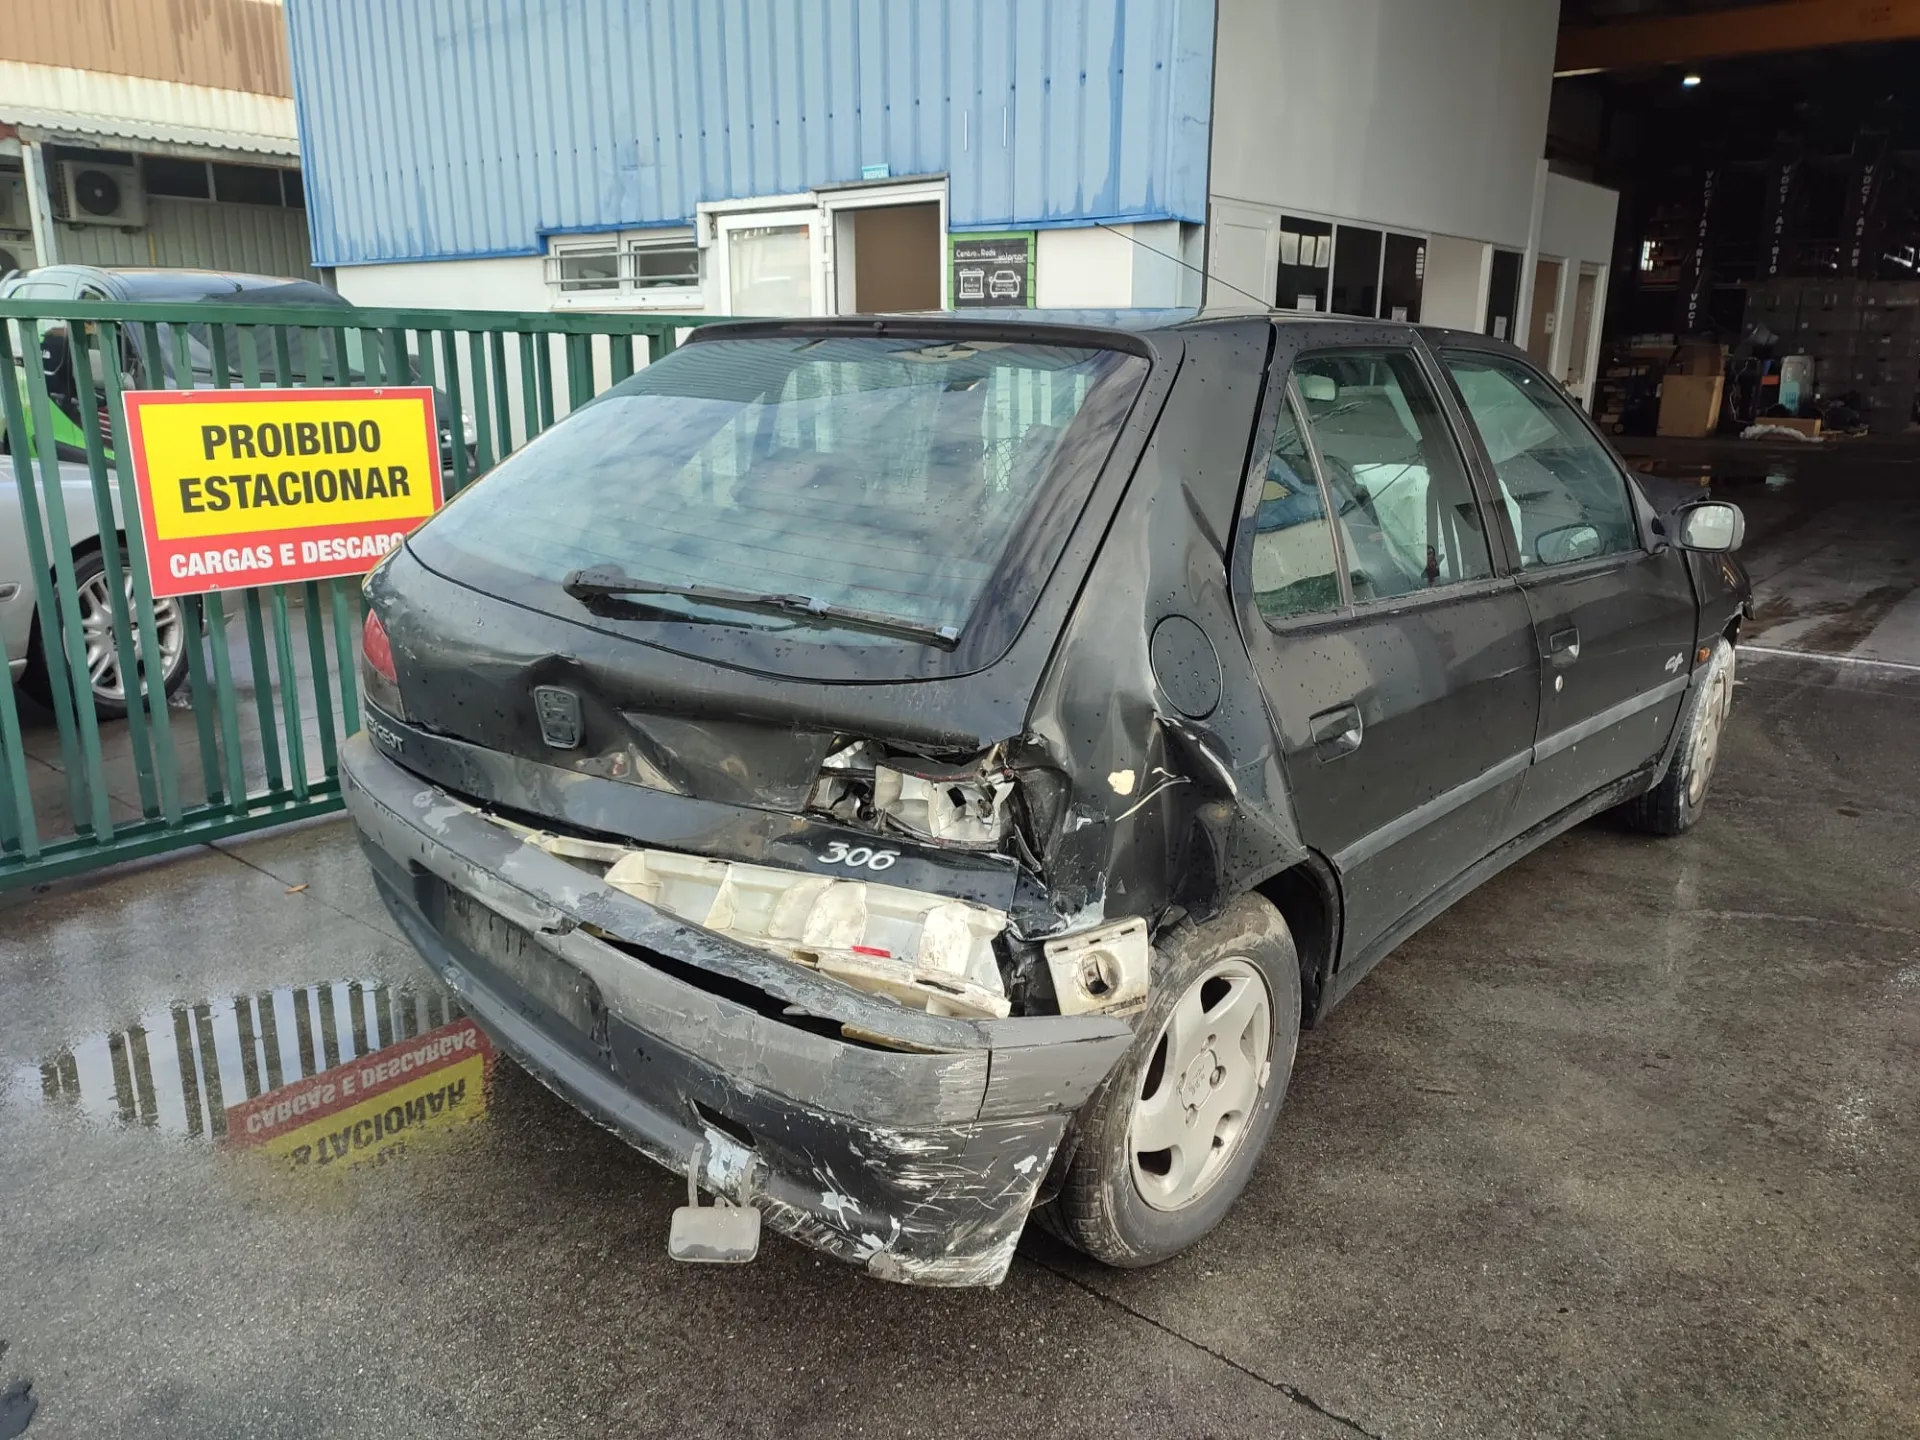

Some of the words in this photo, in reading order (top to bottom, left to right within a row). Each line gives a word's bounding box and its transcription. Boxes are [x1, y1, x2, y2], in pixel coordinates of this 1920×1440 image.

[956, 249, 977, 258] Centro
[201, 419, 380, 460] PROIBIDO
[179, 466, 411, 514] ESTACIONAR
[170, 544, 273, 578] CARGAS
[280, 542, 295, 566] E
[817, 841, 901, 871] 306
